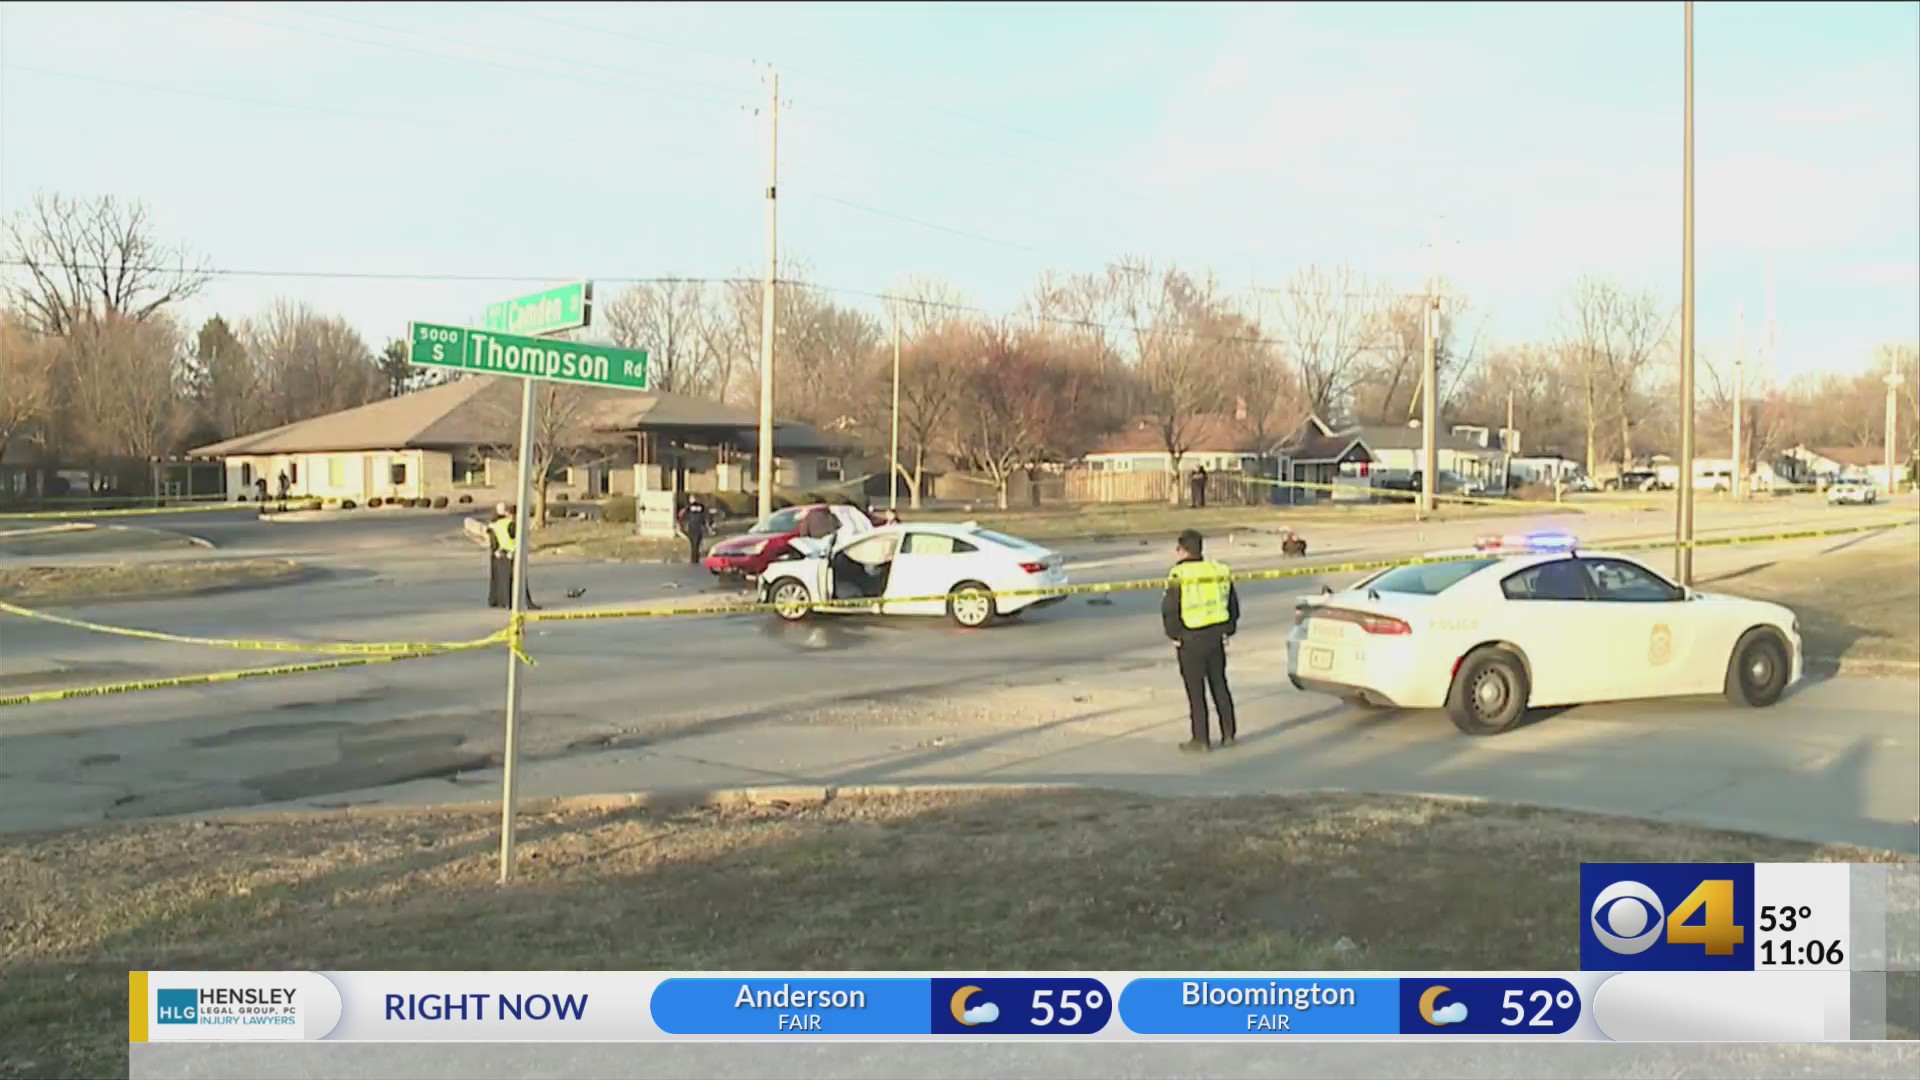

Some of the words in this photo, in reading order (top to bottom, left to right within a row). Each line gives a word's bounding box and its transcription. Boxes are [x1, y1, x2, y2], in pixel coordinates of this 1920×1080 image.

[420, 327, 458, 344] 5000
[432, 344, 445, 362] S
[471, 334, 609, 381] Thompson
[623, 360, 643, 378] Rd
